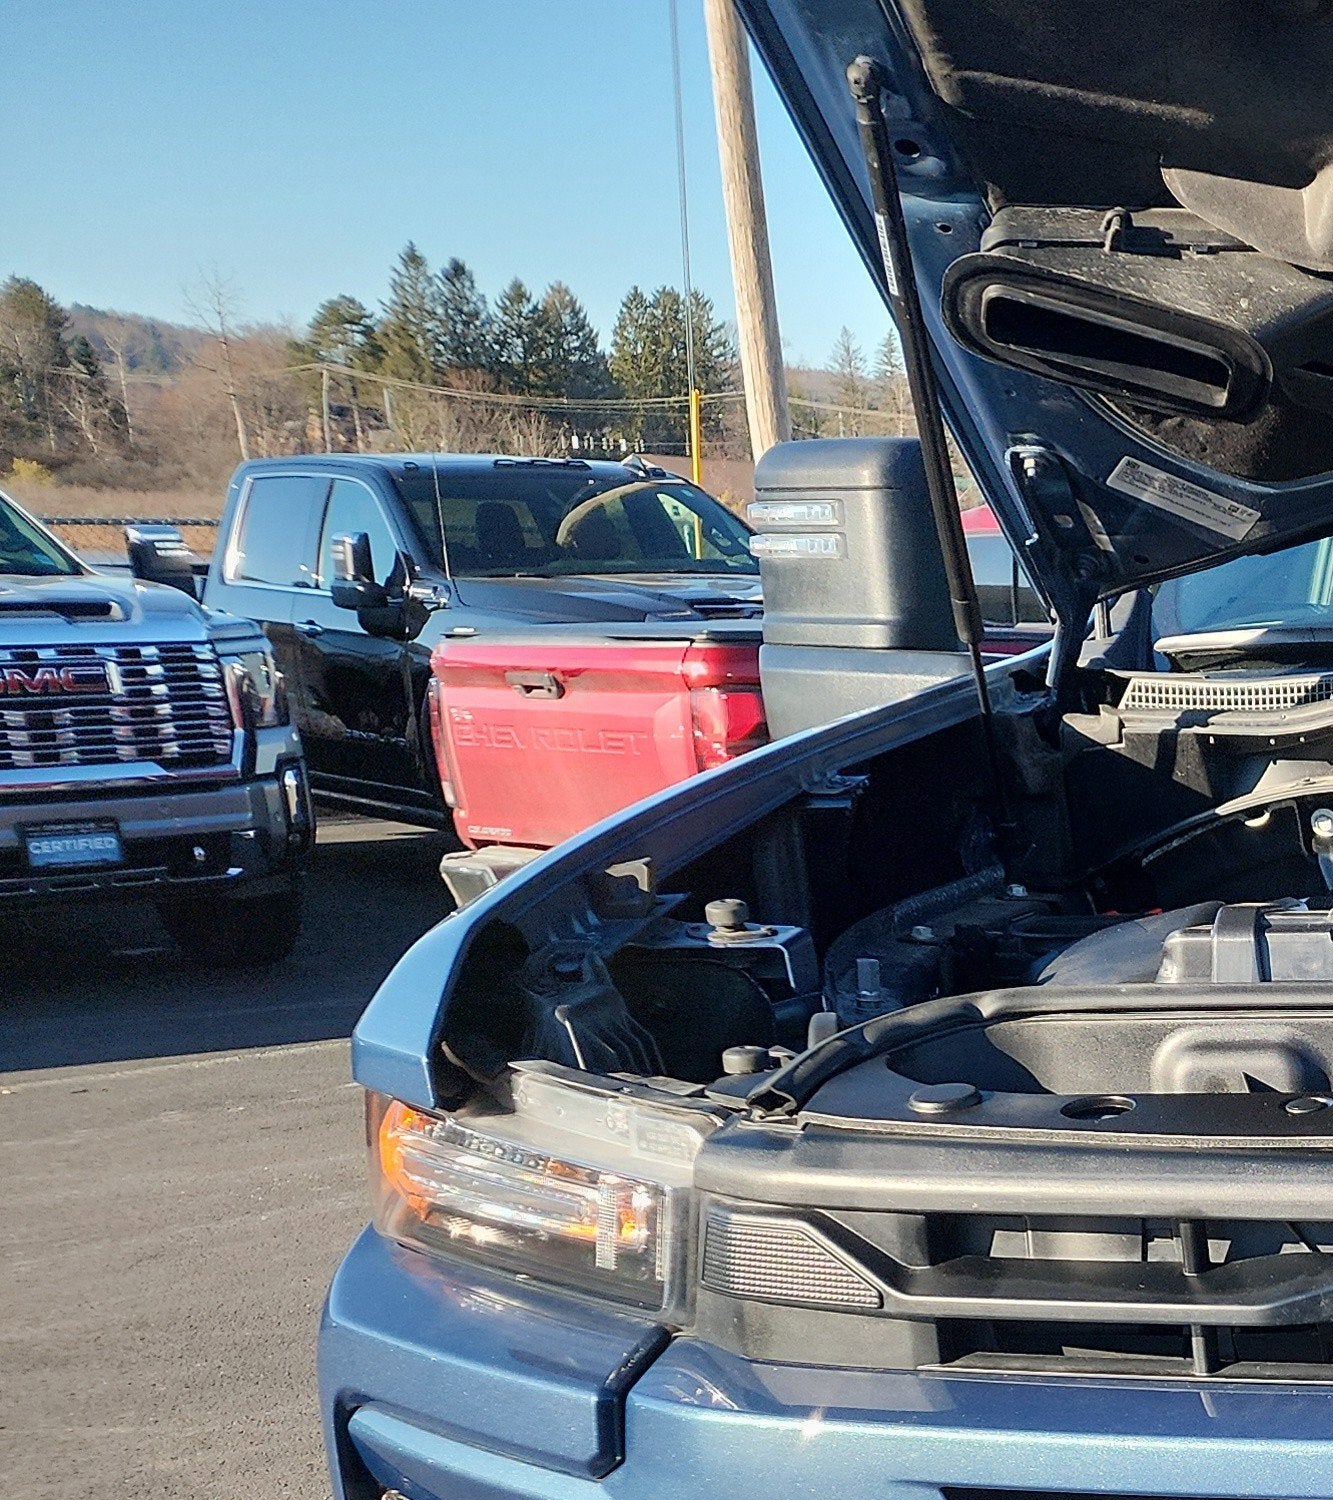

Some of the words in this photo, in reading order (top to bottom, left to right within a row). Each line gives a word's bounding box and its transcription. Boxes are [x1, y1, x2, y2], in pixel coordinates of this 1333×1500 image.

[0, 666, 108, 693] MC
[453, 722, 648, 756] CHEVROLET
[28, 836, 120, 855] CERTIFIED
